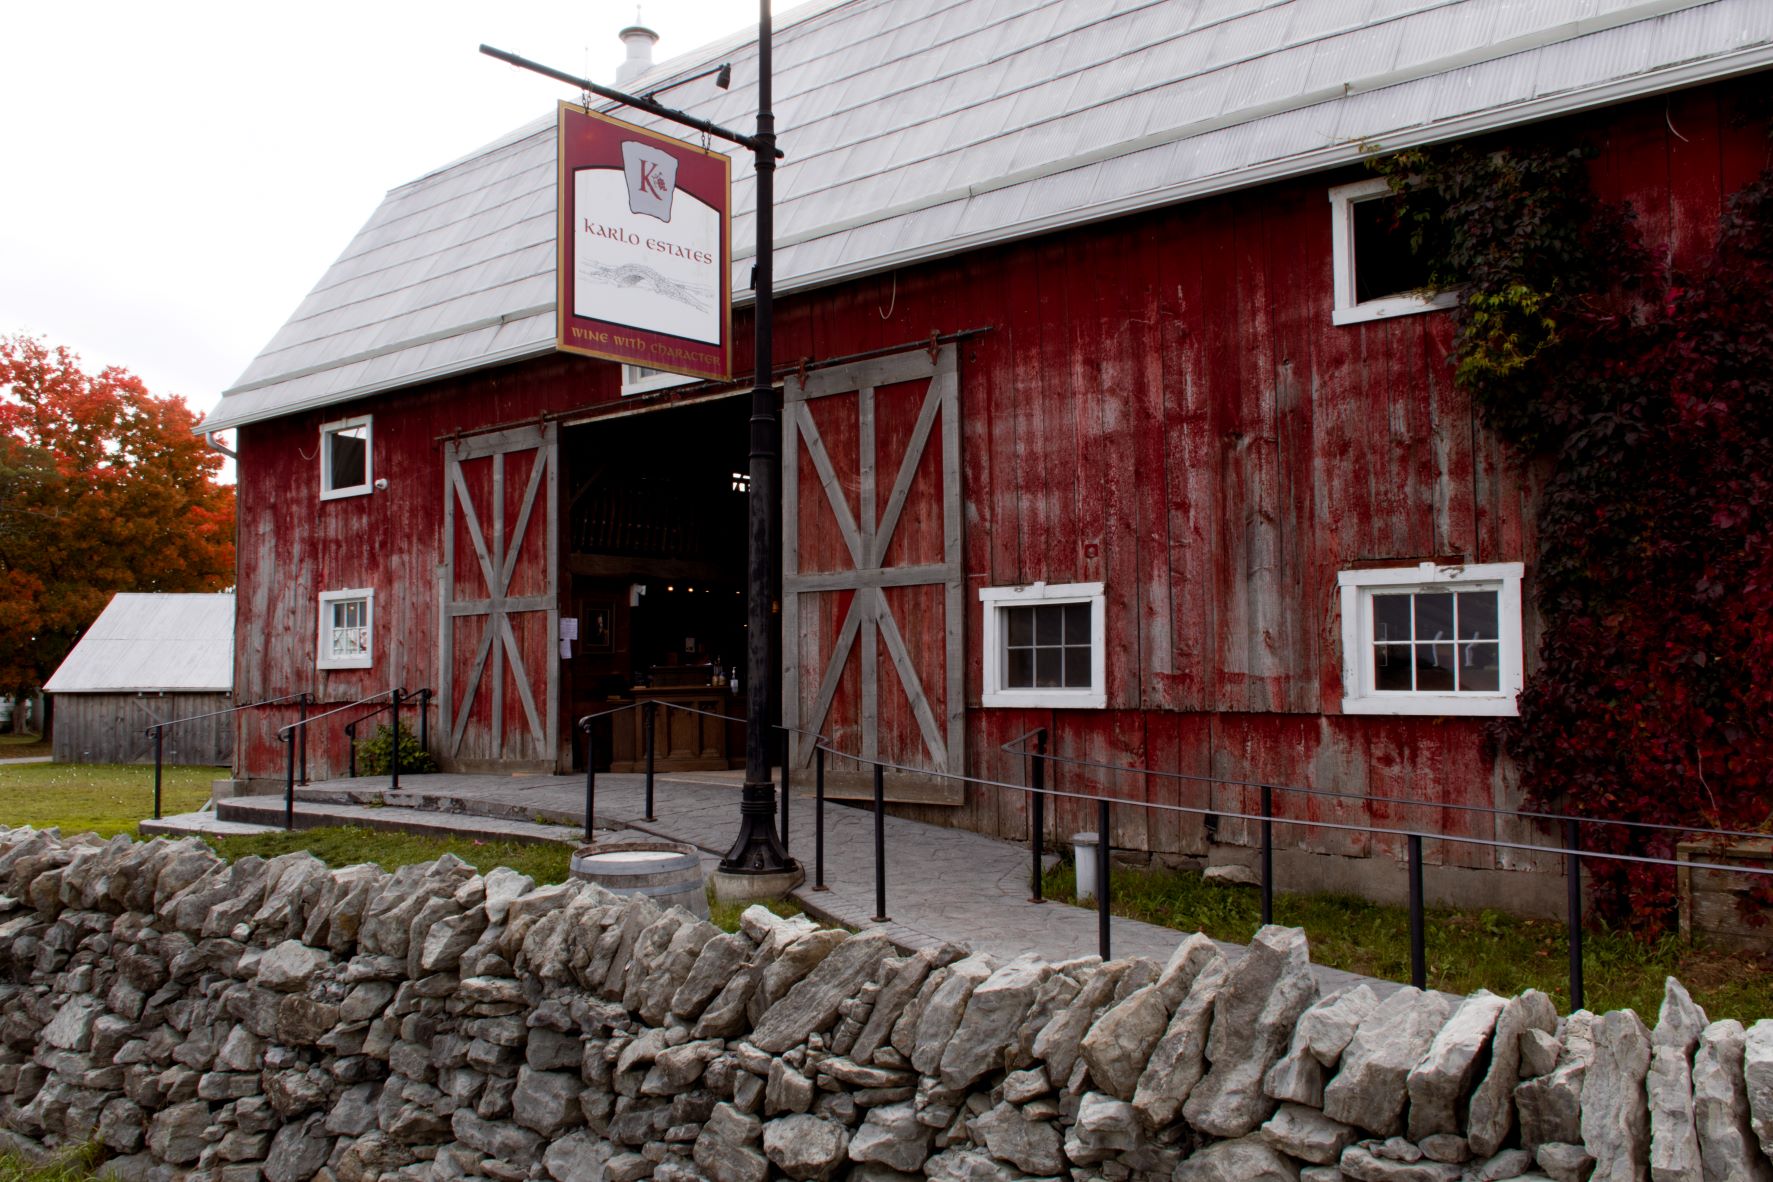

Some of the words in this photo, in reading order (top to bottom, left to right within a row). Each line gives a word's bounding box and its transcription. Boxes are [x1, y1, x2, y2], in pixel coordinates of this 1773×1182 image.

[638, 158, 663, 201] K
[584, 217, 640, 245] KARLO
[646, 238, 713, 265] ESTATES
[571, 326, 609, 343] WINE
